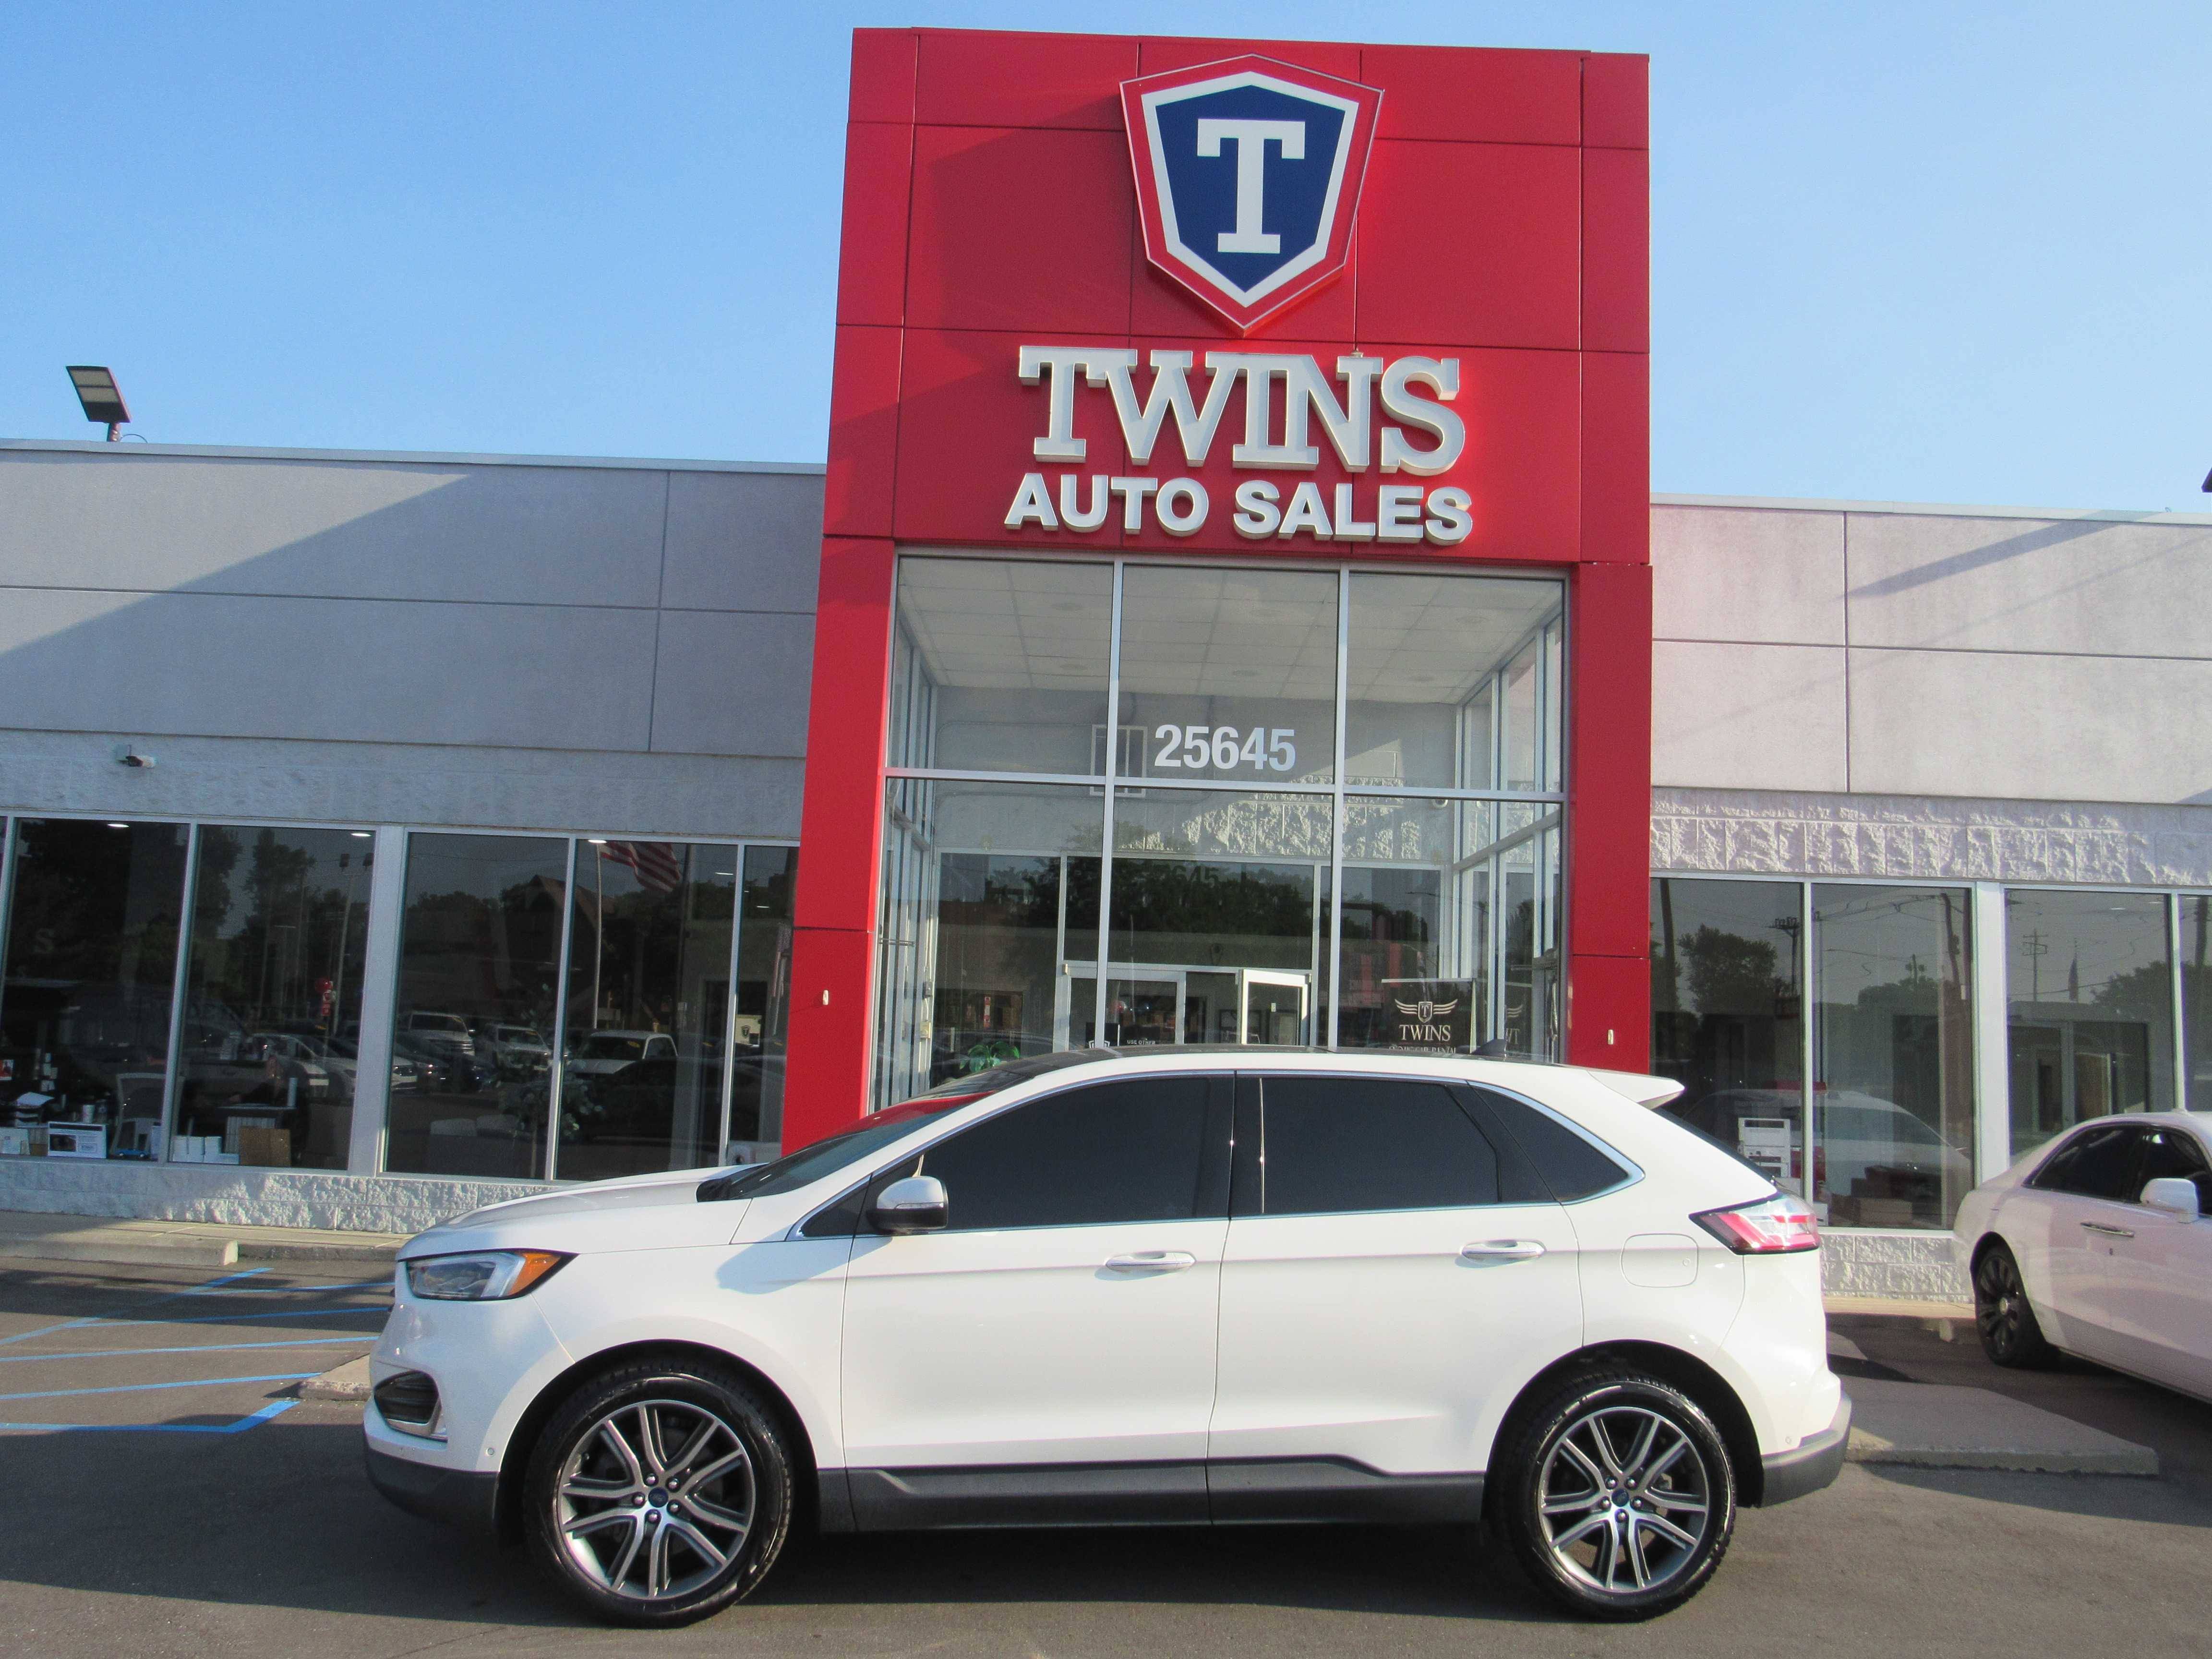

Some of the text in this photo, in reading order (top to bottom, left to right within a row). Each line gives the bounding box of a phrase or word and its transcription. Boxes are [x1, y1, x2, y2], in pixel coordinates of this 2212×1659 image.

[1197, 119, 1306, 254] T
[1019, 345, 1466, 477] TWINS
[1004, 472, 1473, 546] AUTO SALES
[1154, 724, 1296, 771] 25645
[1399, 1024, 1451, 1042] TWINS
